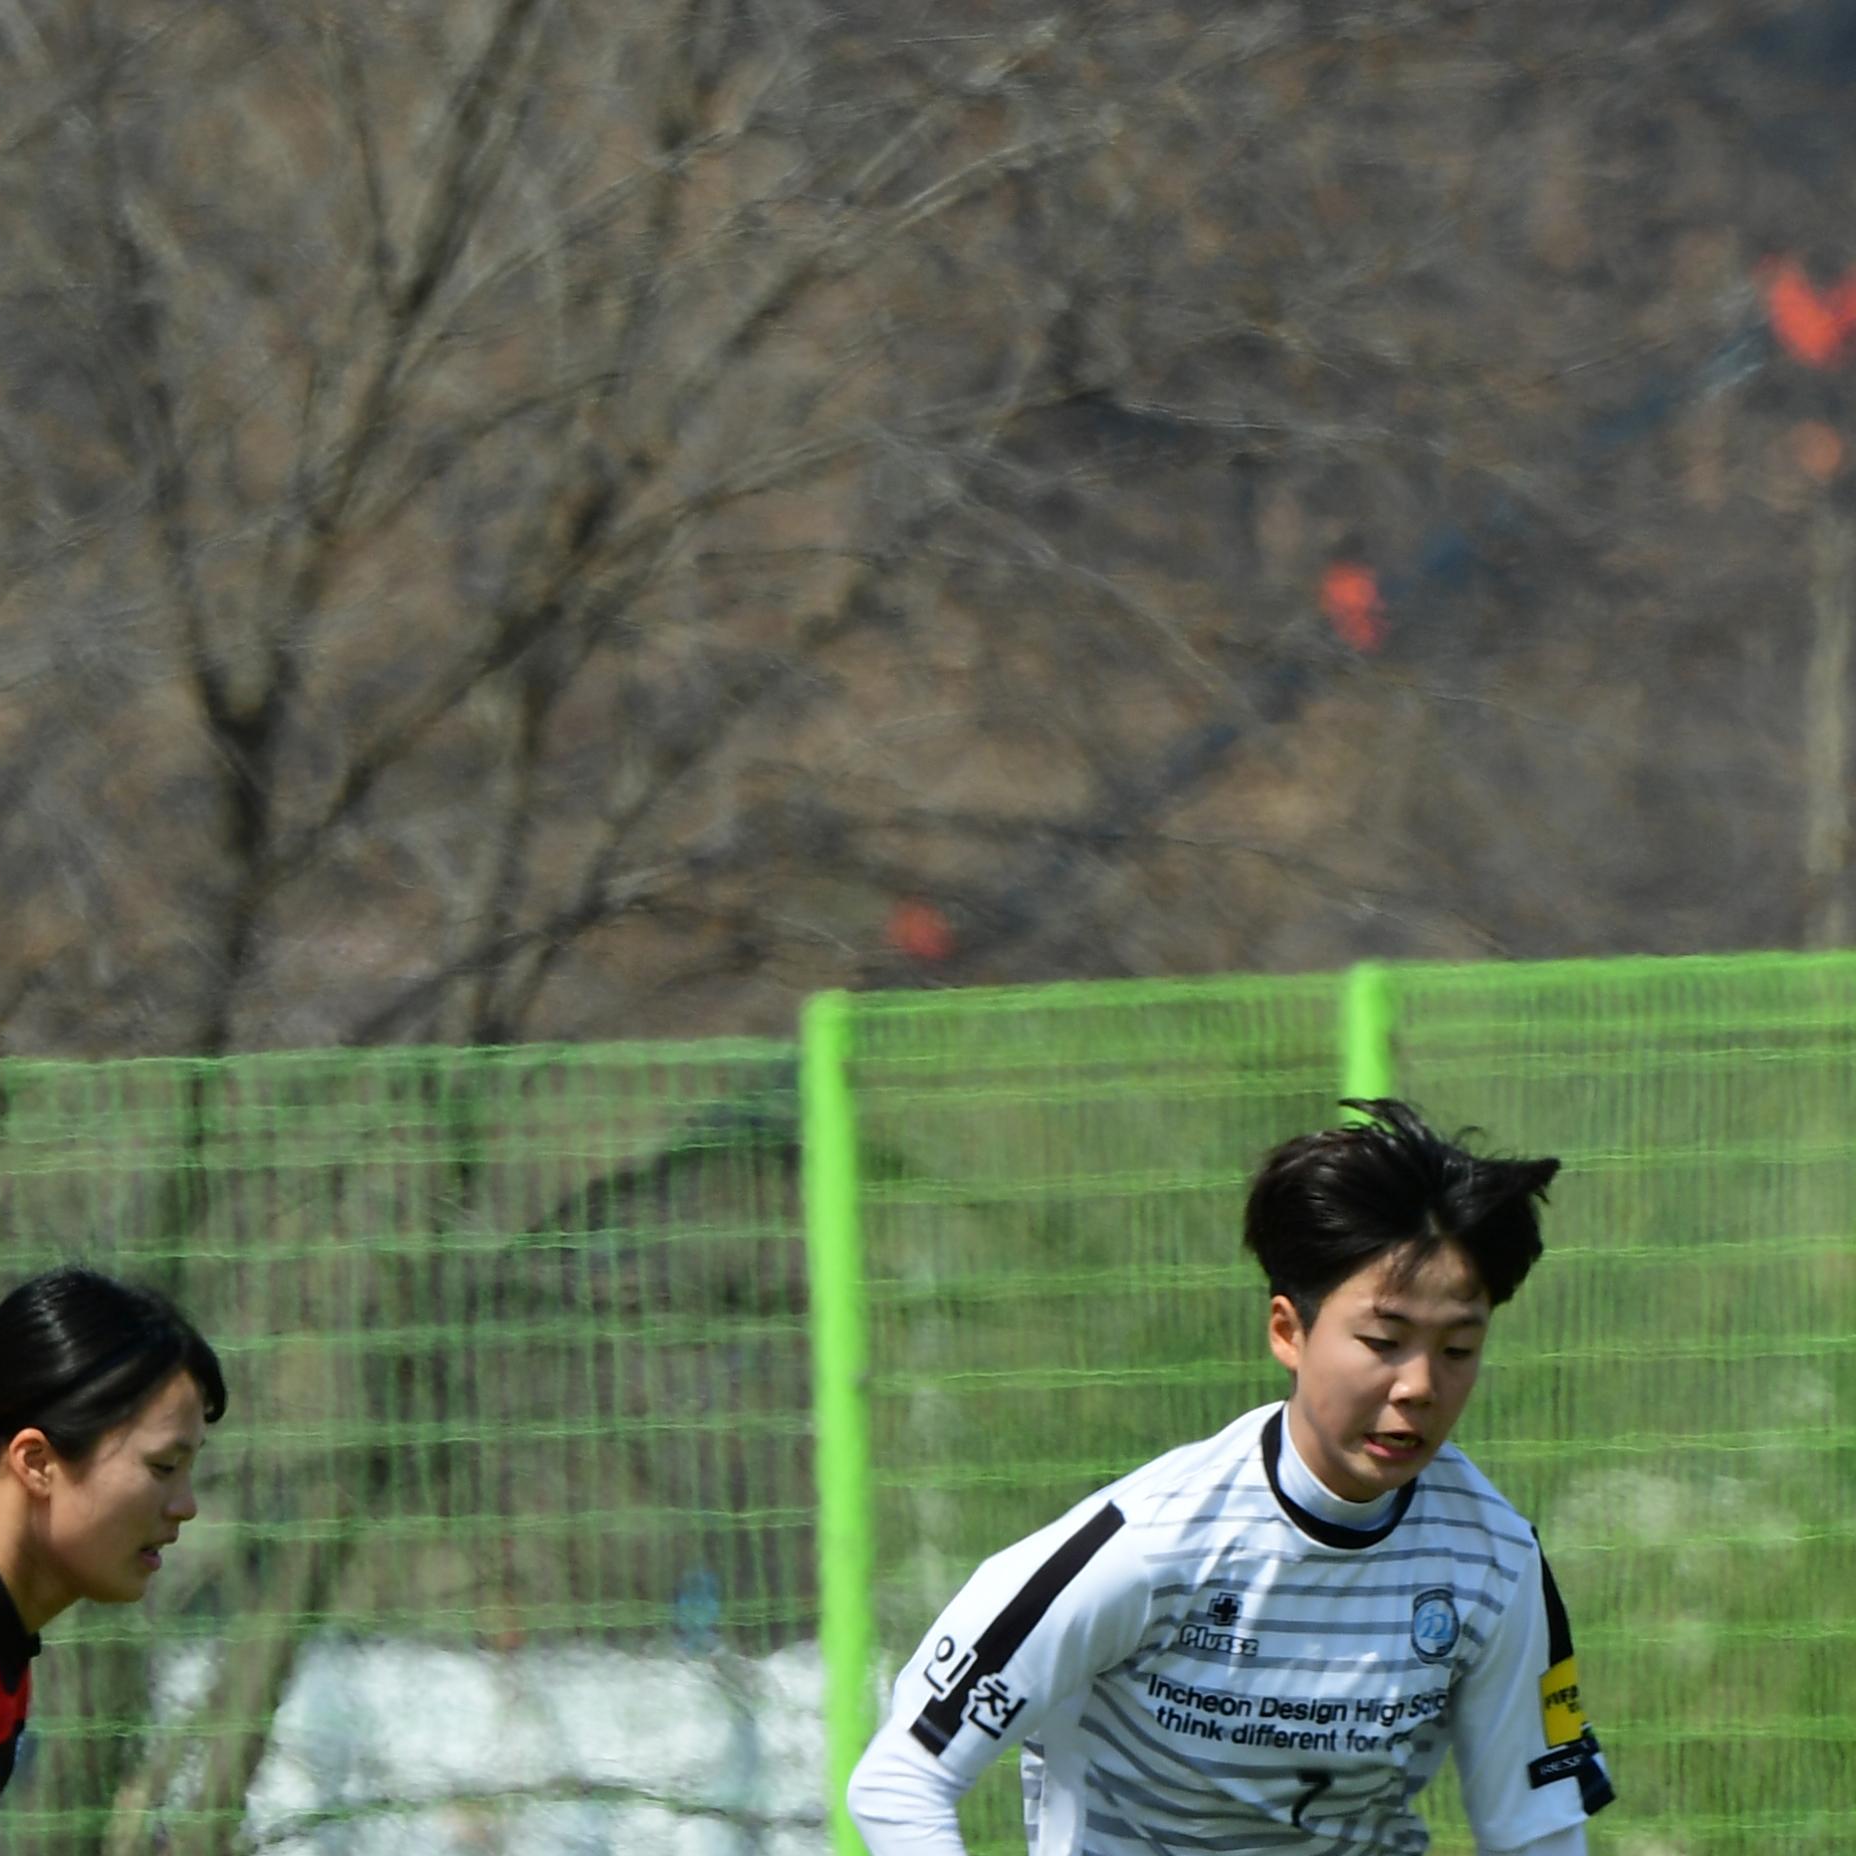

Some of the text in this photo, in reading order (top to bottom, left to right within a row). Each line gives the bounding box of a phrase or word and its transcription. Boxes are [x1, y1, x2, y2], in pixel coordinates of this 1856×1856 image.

[1180, 1624, 1260, 1656] Plussz
[923, 1635, 1028, 1741] 인천
[1148, 1674, 1252, 1717] Incheon
[1258, 1697, 1349, 1725] Design
[1157, 1706, 1223, 1741] think
[1231, 1721, 1337, 1751] different
[1346, 1728, 1380, 1753] for
[1291, 1768, 1333, 1827] 7
